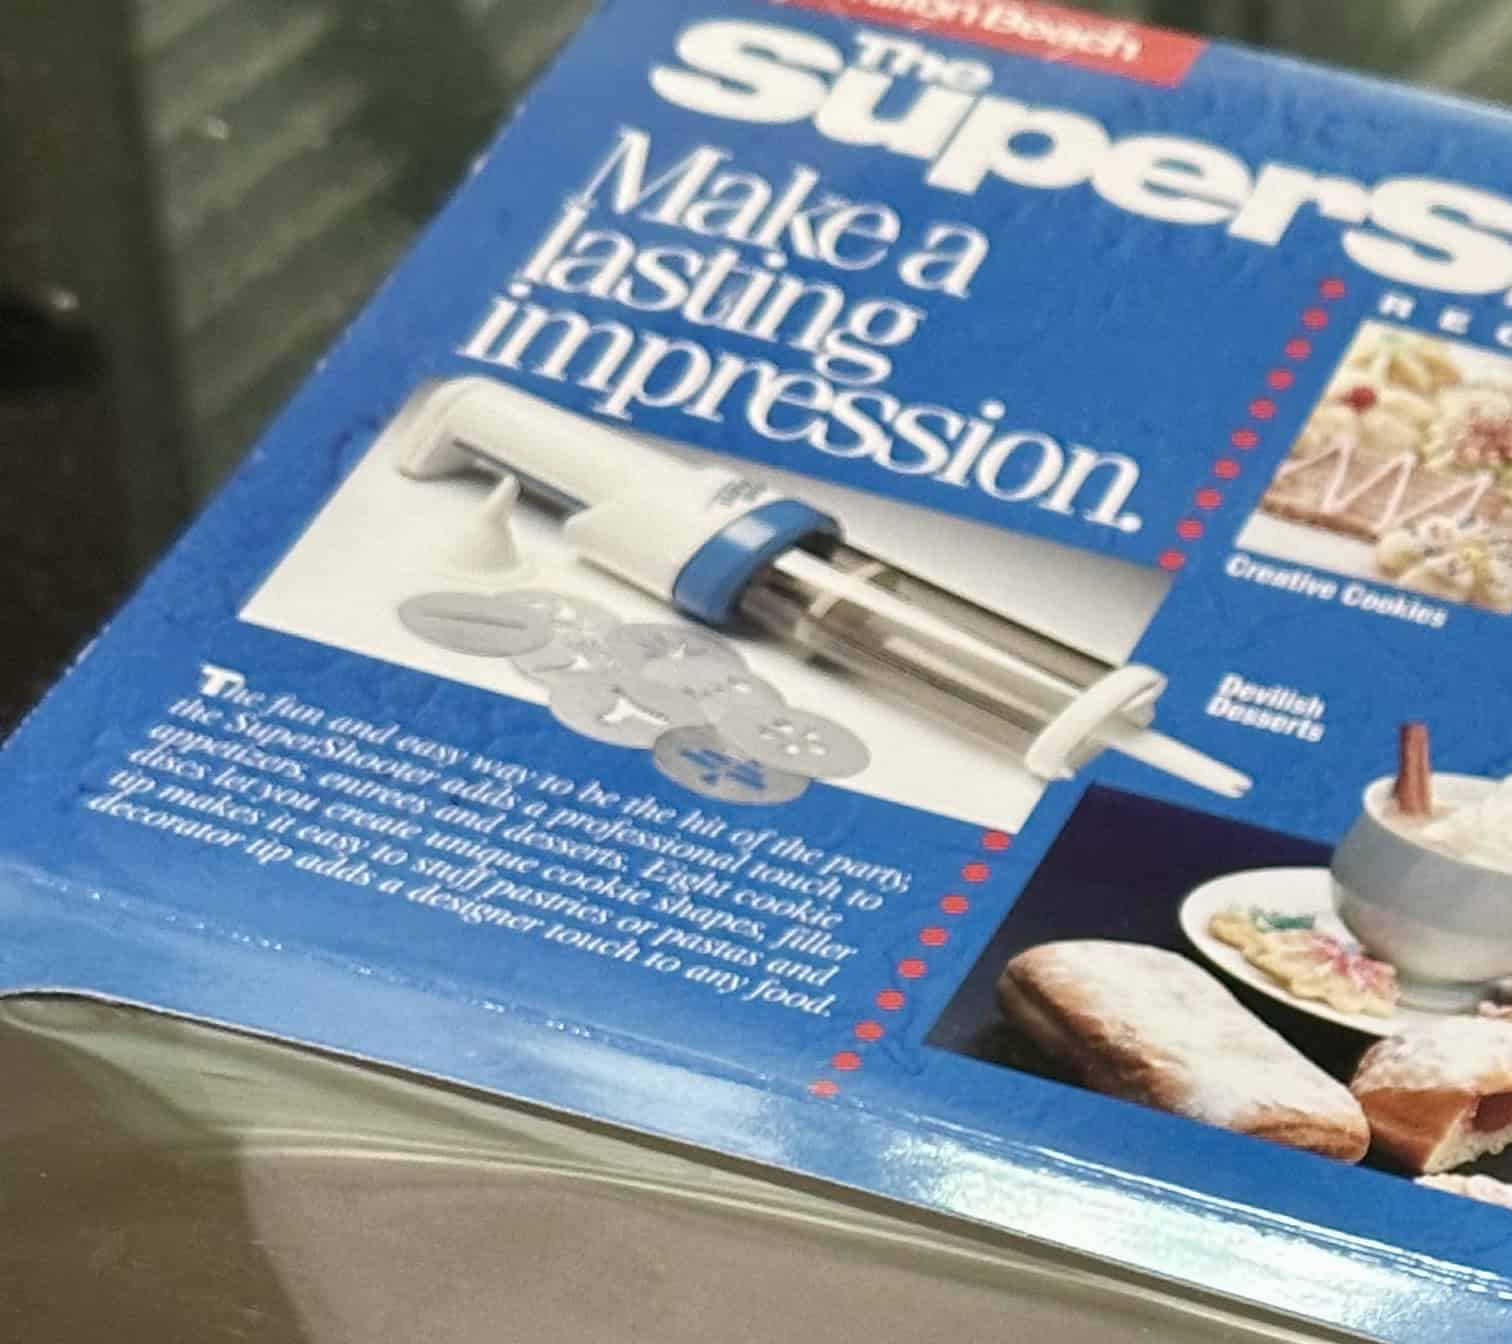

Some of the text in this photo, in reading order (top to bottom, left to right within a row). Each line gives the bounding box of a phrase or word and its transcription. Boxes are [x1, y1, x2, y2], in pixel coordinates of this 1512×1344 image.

[856, 28, 994, 92] The
[524, 200, 926, 386] lasting
[577, 126, 989, 300] Make a
[458, 282, 1142, 535] impression.
[1224, 552, 1449, 629] Creative Cookies
[199, 662, 266, 706] The
[261, 692, 325, 726] fun
[327, 715, 401, 745] and
[396, 736, 469, 767] easy
[471, 754, 537, 784] way
[537, 774, 575, 795] to
[577, 780, 621, 808] be
[622, 796, 677, 824] the
[677, 807, 728, 839] hit
[728, 828, 778, 851] of
[769, 836, 824, 865] the
[1203, 694, 1326, 743] Desserts
[1217, 671, 1326, 721] Devilish
[107, 769, 840, 987] tip makes it easy to stuff pastries or pastas and
[128, 749, 858, 961] discs let you create unique cookie shapes, filler
[168, 698, 884, 911] the SuperShooter adds a professional touch to
[318, 773, 432, 815] entrees
[433, 805, 507, 833] and
[641, 856, 731, 898] Eight
[735, 887, 844, 930] cookie
[88, 795, 836, 1018] decorator tip adds a designer touch to any food.
